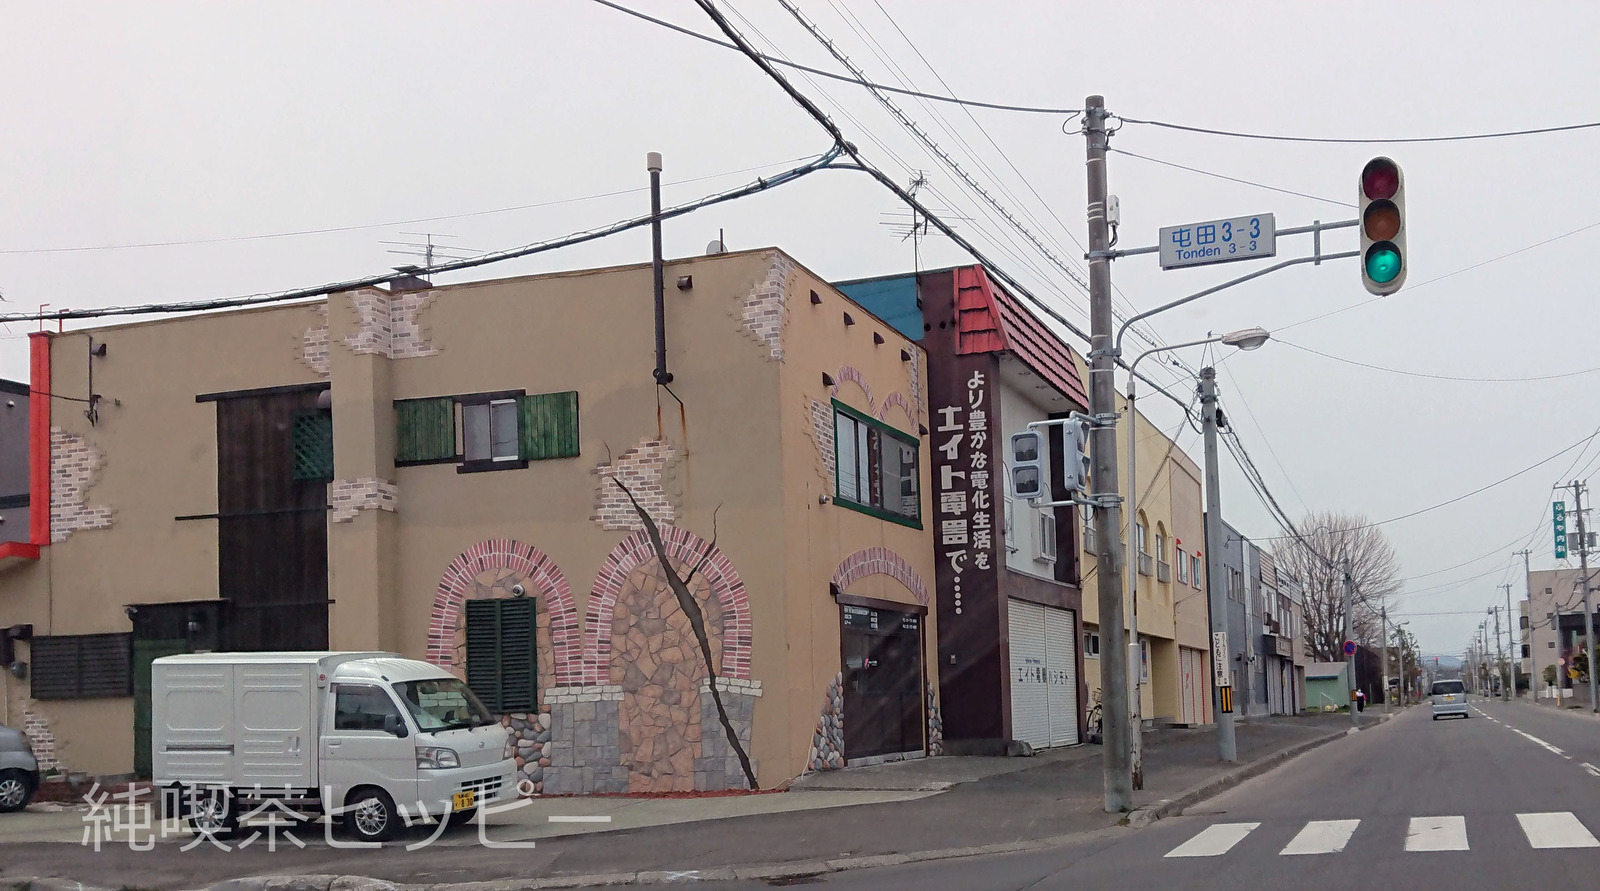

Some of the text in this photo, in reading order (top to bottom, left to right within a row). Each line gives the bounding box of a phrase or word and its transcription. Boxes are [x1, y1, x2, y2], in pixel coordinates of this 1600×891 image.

[1176, 247, 1220, 260] Tonden
[967, 370, 991, 570] より豊かな電化生活を
[1555, 503, 1565, 553] ふるや内科
